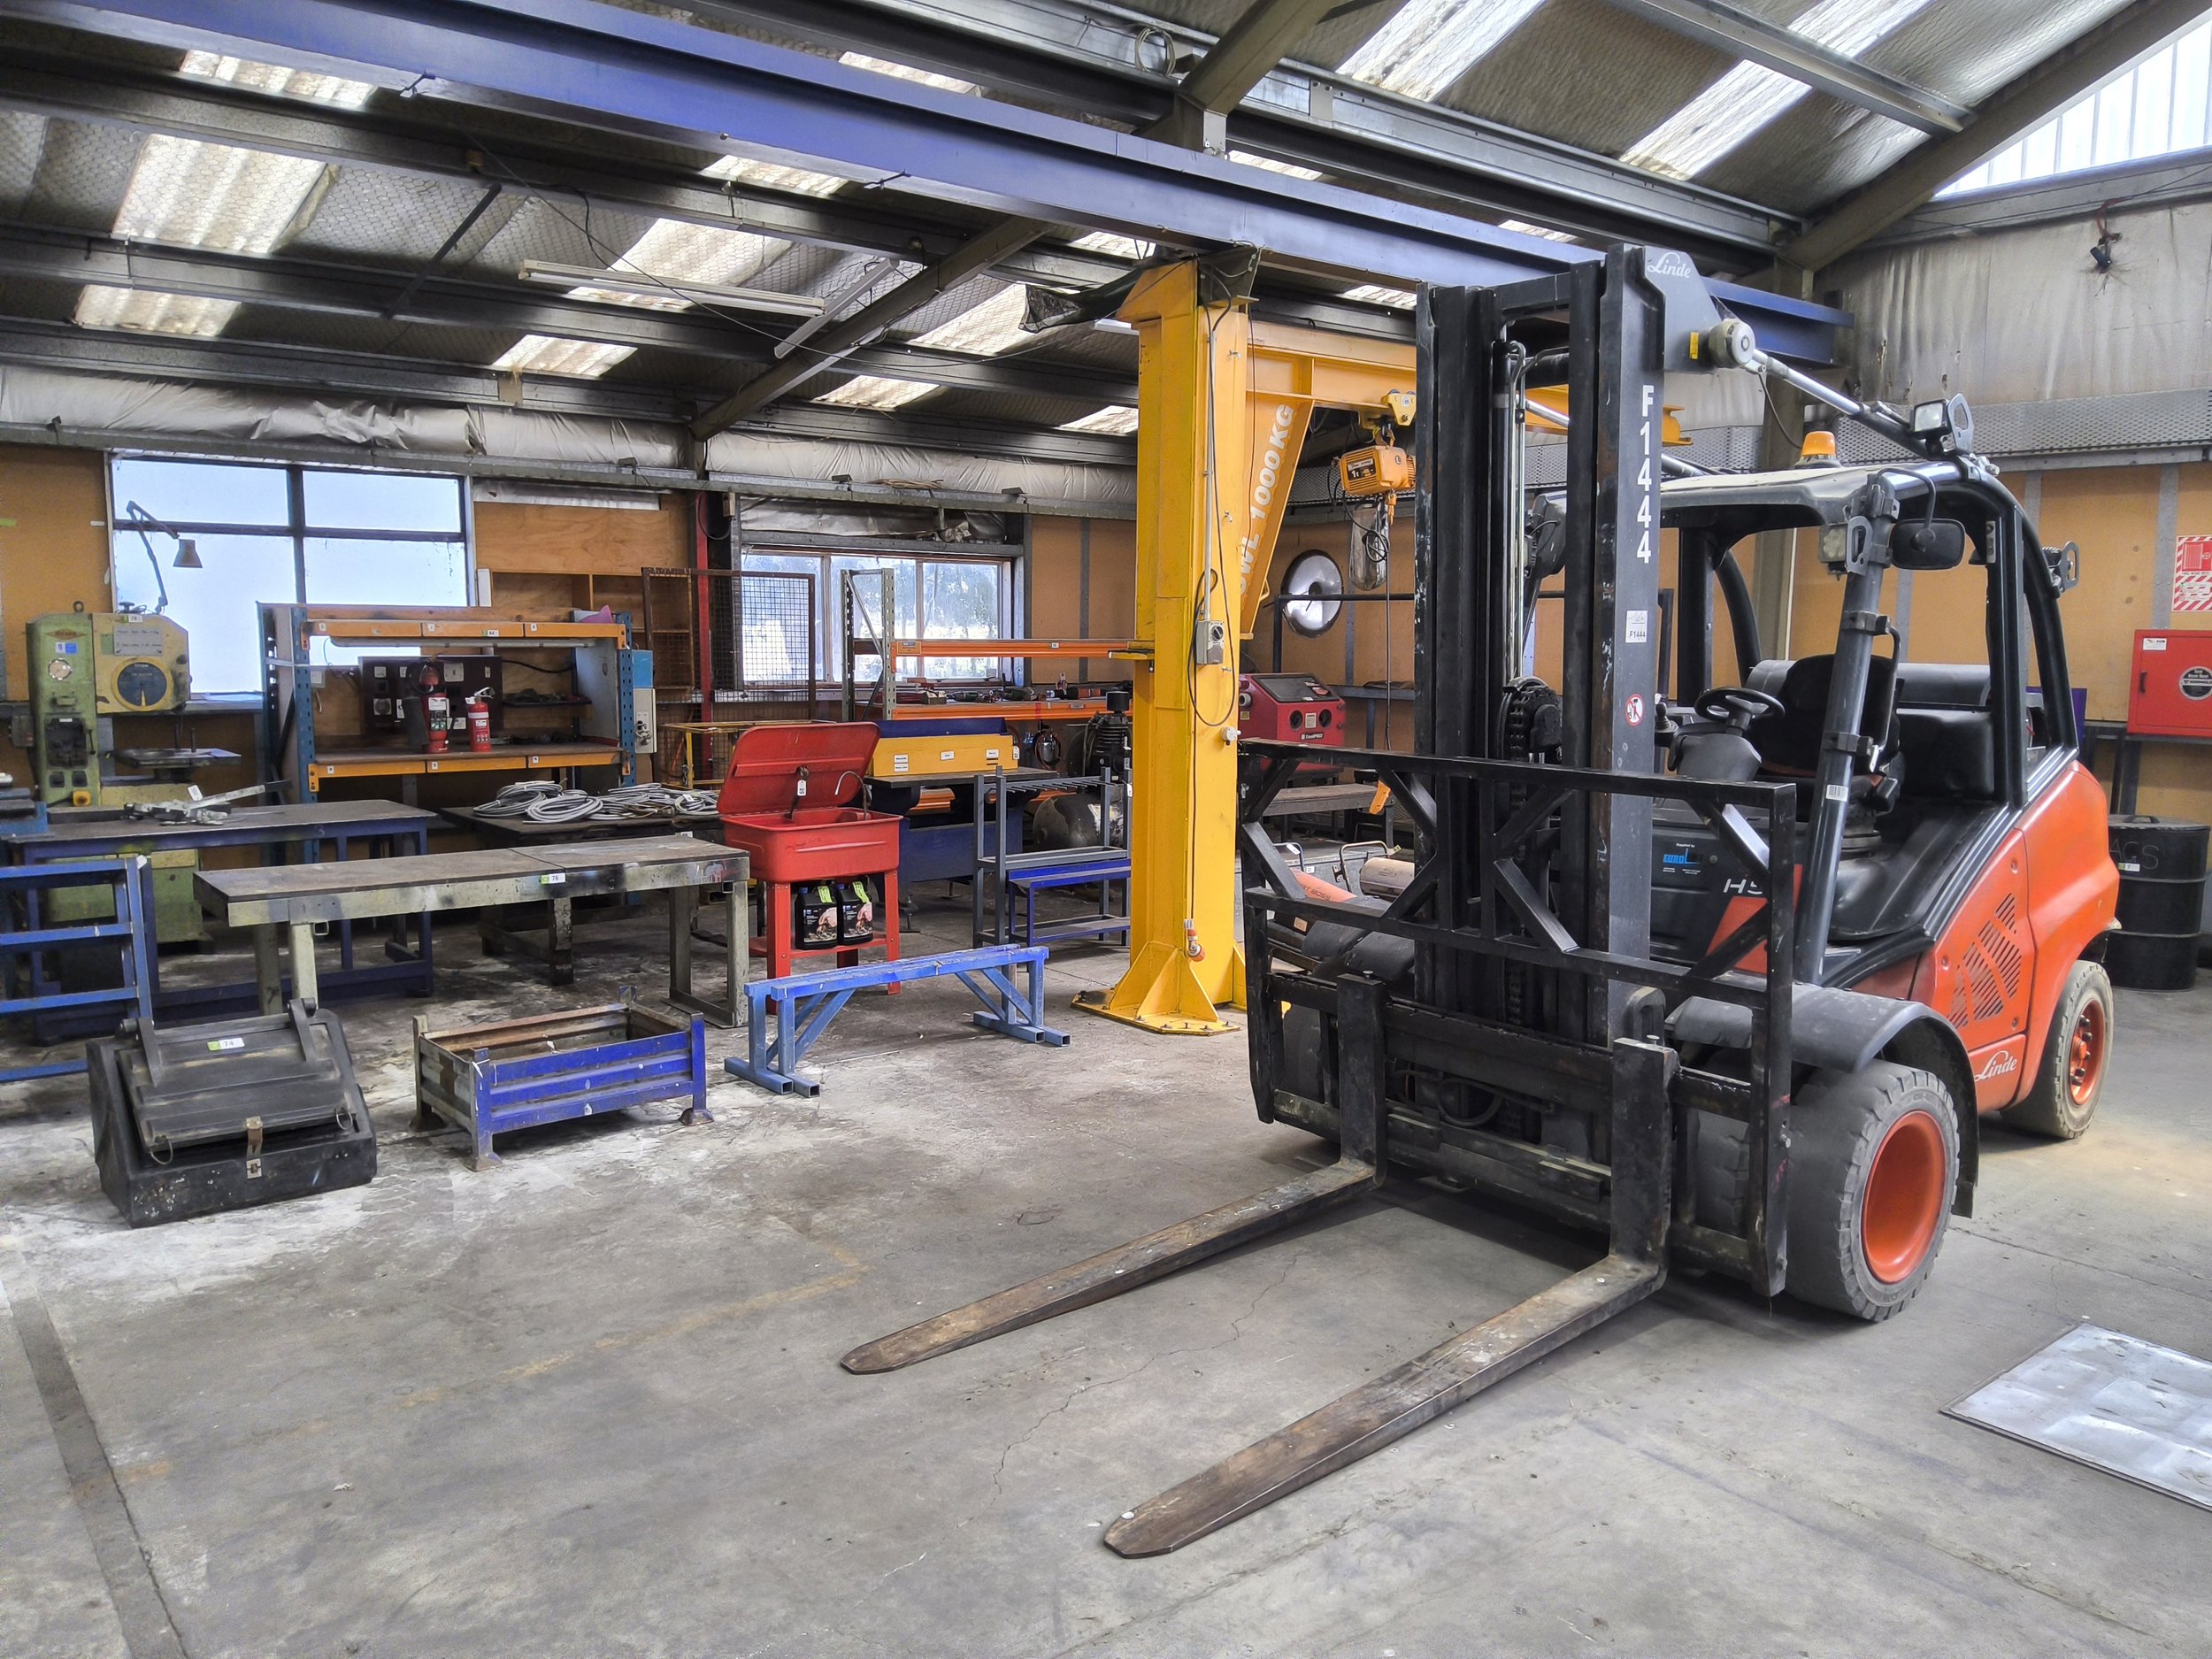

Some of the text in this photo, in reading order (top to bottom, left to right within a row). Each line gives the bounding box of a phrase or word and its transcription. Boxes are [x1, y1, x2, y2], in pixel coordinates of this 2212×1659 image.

[1647, 252, 1691, 278] Linde
[1250, 449, 1280, 519] 1000
[1269, 403, 1294, 449] KG
[1637, 385, 1655, 564] F1444
[1974, 1050, 2017, 1082] Linde
